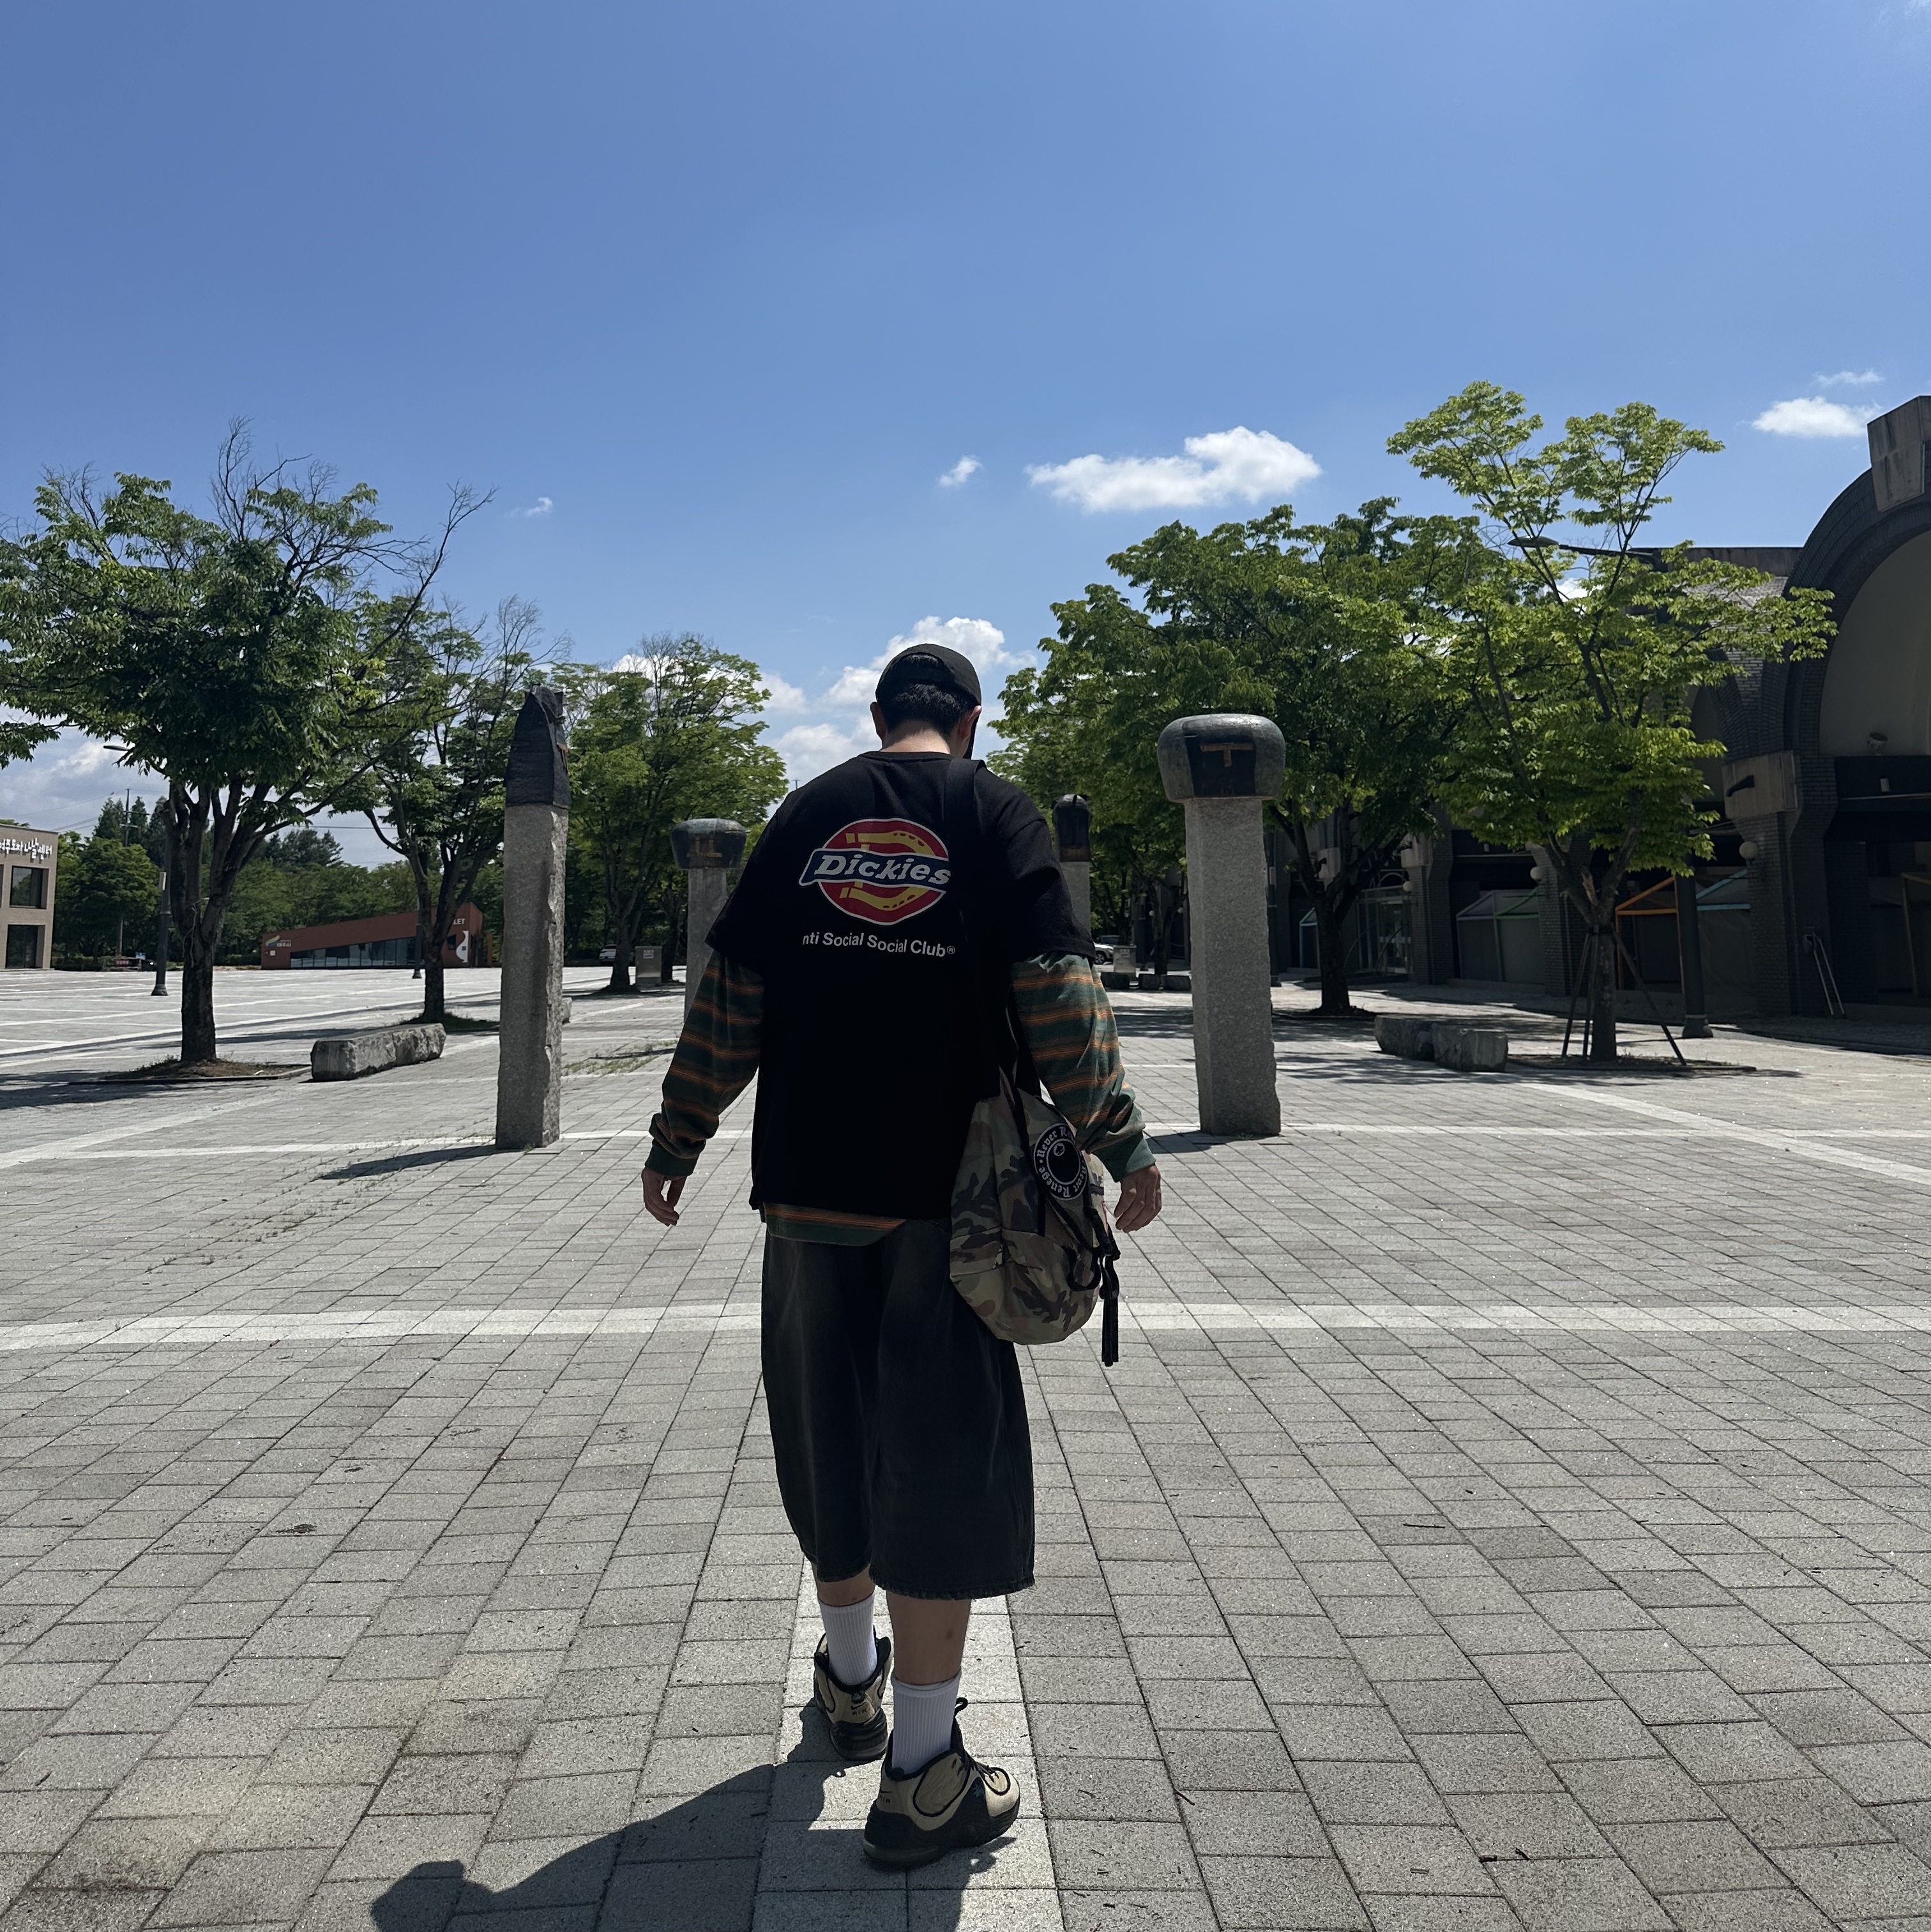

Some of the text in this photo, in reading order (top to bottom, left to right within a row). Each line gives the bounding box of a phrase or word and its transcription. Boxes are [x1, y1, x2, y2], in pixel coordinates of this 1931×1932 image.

[814, 854, 951, 885] Dickies
[822, 932, 865, 946] Social
[867, 934, 907, 953] Social
